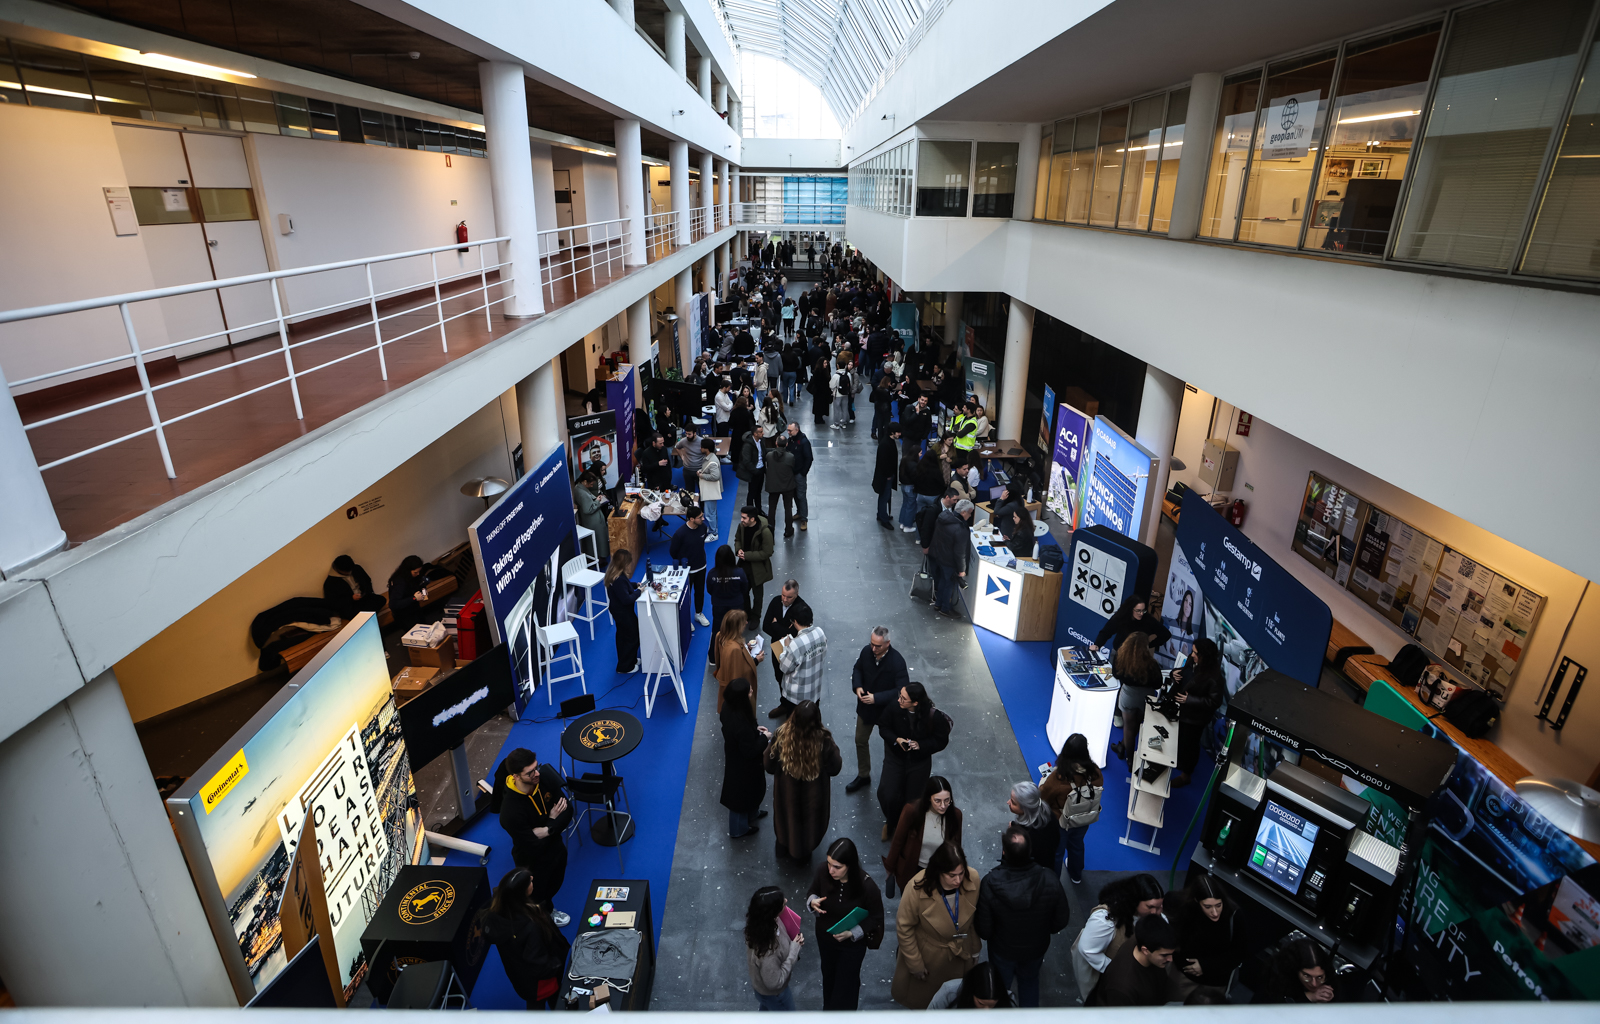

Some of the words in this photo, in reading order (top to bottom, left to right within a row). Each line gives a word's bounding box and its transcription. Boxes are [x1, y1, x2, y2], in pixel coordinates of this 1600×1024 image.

[581, 418, 601, 427] LIFETEC
[1060, 427, 1078, 447] ACA
[1089, 473, 1115, 507] NUNCA
[485, 525, 500, 543] TAKING
[498, 519, 507, 532] OFF
[505, 501, 524, 523] TOGETHER
[1085, 499, 1096, 517] DE
[1087, 487, 1124, 531] PARAMOS
[492, 549, 514, 577] Taking
[512, 536, 522, 553] off
[519, 514, 544, 544] together.
[1223, 536, 1252, 570] Gestamp
[495, 572, 513, 594] With
[511, 558, 525, 579] you.
[1067, 627, 1095, 648] Gestam
[1251, 719, 1299, 748] Introducing
[207, 767, 239, 804] Continental
[1360, 772, 1383, 788] 4000
[330, 836, 385, 928] UTURE
[401, 883, 429, 922] CONTINENTAL
[1448, 921, 1467, 942] OF
